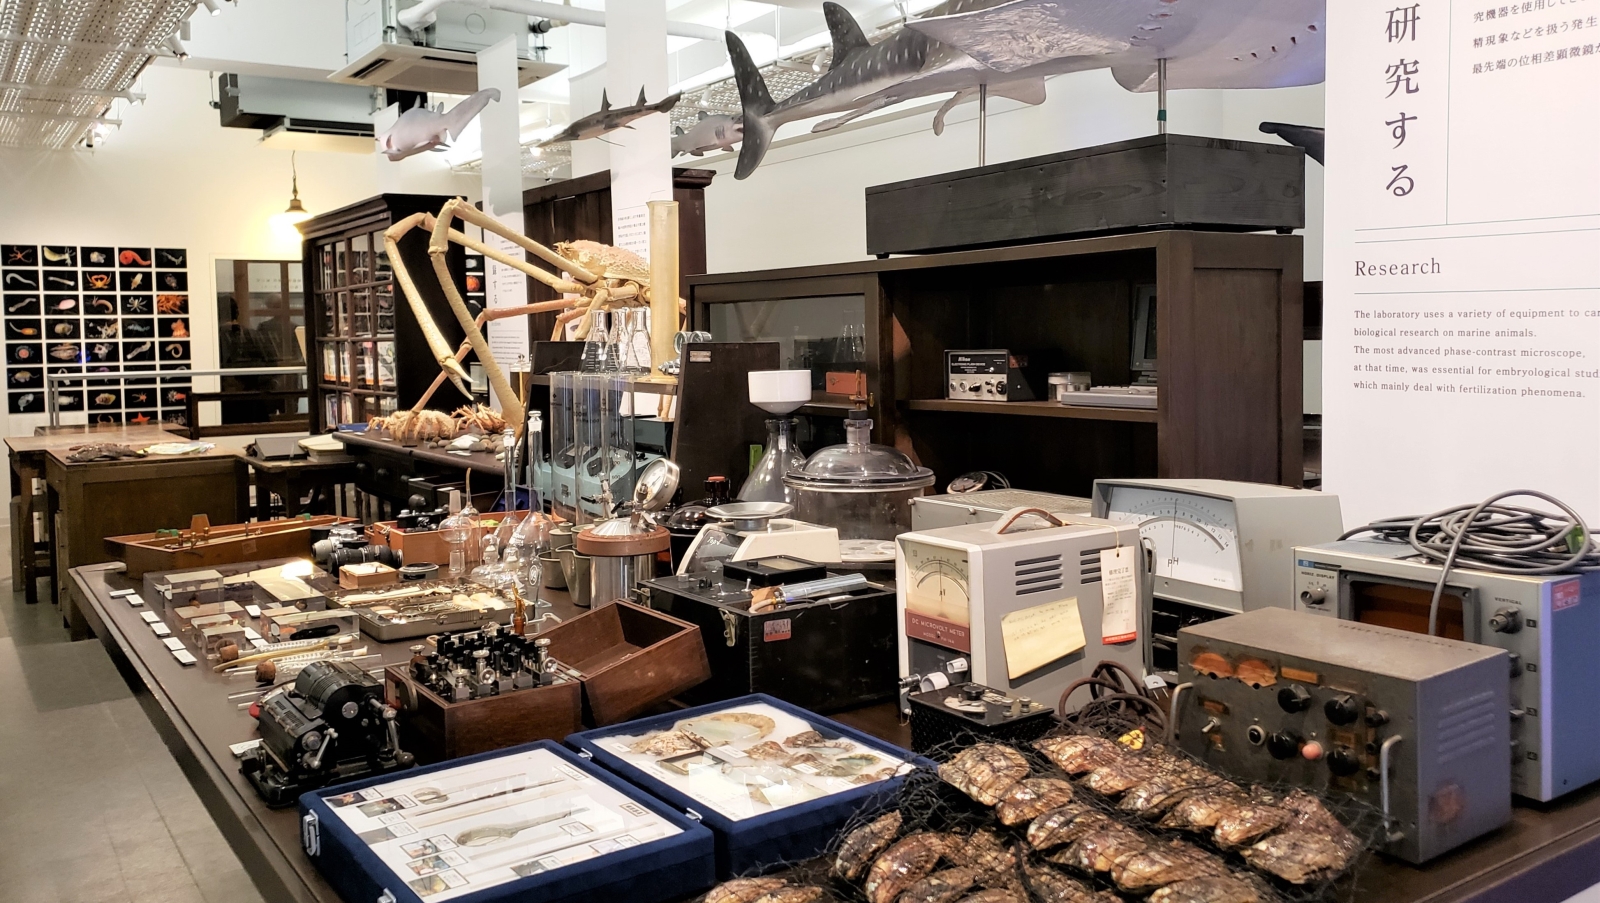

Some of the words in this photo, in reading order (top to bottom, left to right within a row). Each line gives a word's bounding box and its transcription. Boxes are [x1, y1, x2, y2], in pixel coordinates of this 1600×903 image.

[1473, 16, 1598, 48] 精現象などを扱う発生
[1385, 3, 1421, 197] 研究する
[1354, 257, 1442, 277] Research
[1354, 309, 1370, 319] The
[1374, 309, 1420, 320] laboratory
[1424, 311, 1444, 319] uses
[1449, 311, 1453, 319] a
[1457, 308, 1492, 320] variety
[1496, 308, 1506, 318] of
[1510, 308, 1564, 320] equipment
[1569, 309, 1579, 318] to
[1354, 327, 1396, 338] biological
[1400, 327, 1439, 337] research
[1443, 329, 1454, 337] on
[1458, 327, 1490, 338] marine
[1495, 327, 1536, 338] animals.
[1354, 344, 1370, 355] The
[1374, 346, 1394, 355] most
[1398, 345, 1440, 356] advanced
[1444, 346, 1516, 357] phase-contrast
[1521, 347, 1585, 360] microscope,
[1354, 363, 1362, 372] at
[1365, 362, 1382, 373] that
[1385, 363, 1407, 374] time,
[1412, 366, 1428, 374] was
[1432, 365, 1474, 375] essential
[1478, 365, 1492, 376] for
[1496, 366, 1570, 379] embryological
[1575, 368, 1600, 379] stud
[1354, 380, 1378, 390] which
[1381, 381, 1410, 393] mainly
[1413, 382, 1432, 392] deal
[1436, 383, 1455, 393] with
[1459, 383, 1517, 396] fertilization
[1521, 386, 1585, 398] phenomena.
[1167, 556, 1179, 568] pH
[1494, 597, 1522, 605] VERTICAL
[911, 617, 919, 625] DC
[920, 620, 948, 632] MICROVOLT
[949, 628, 965, 637] METER
